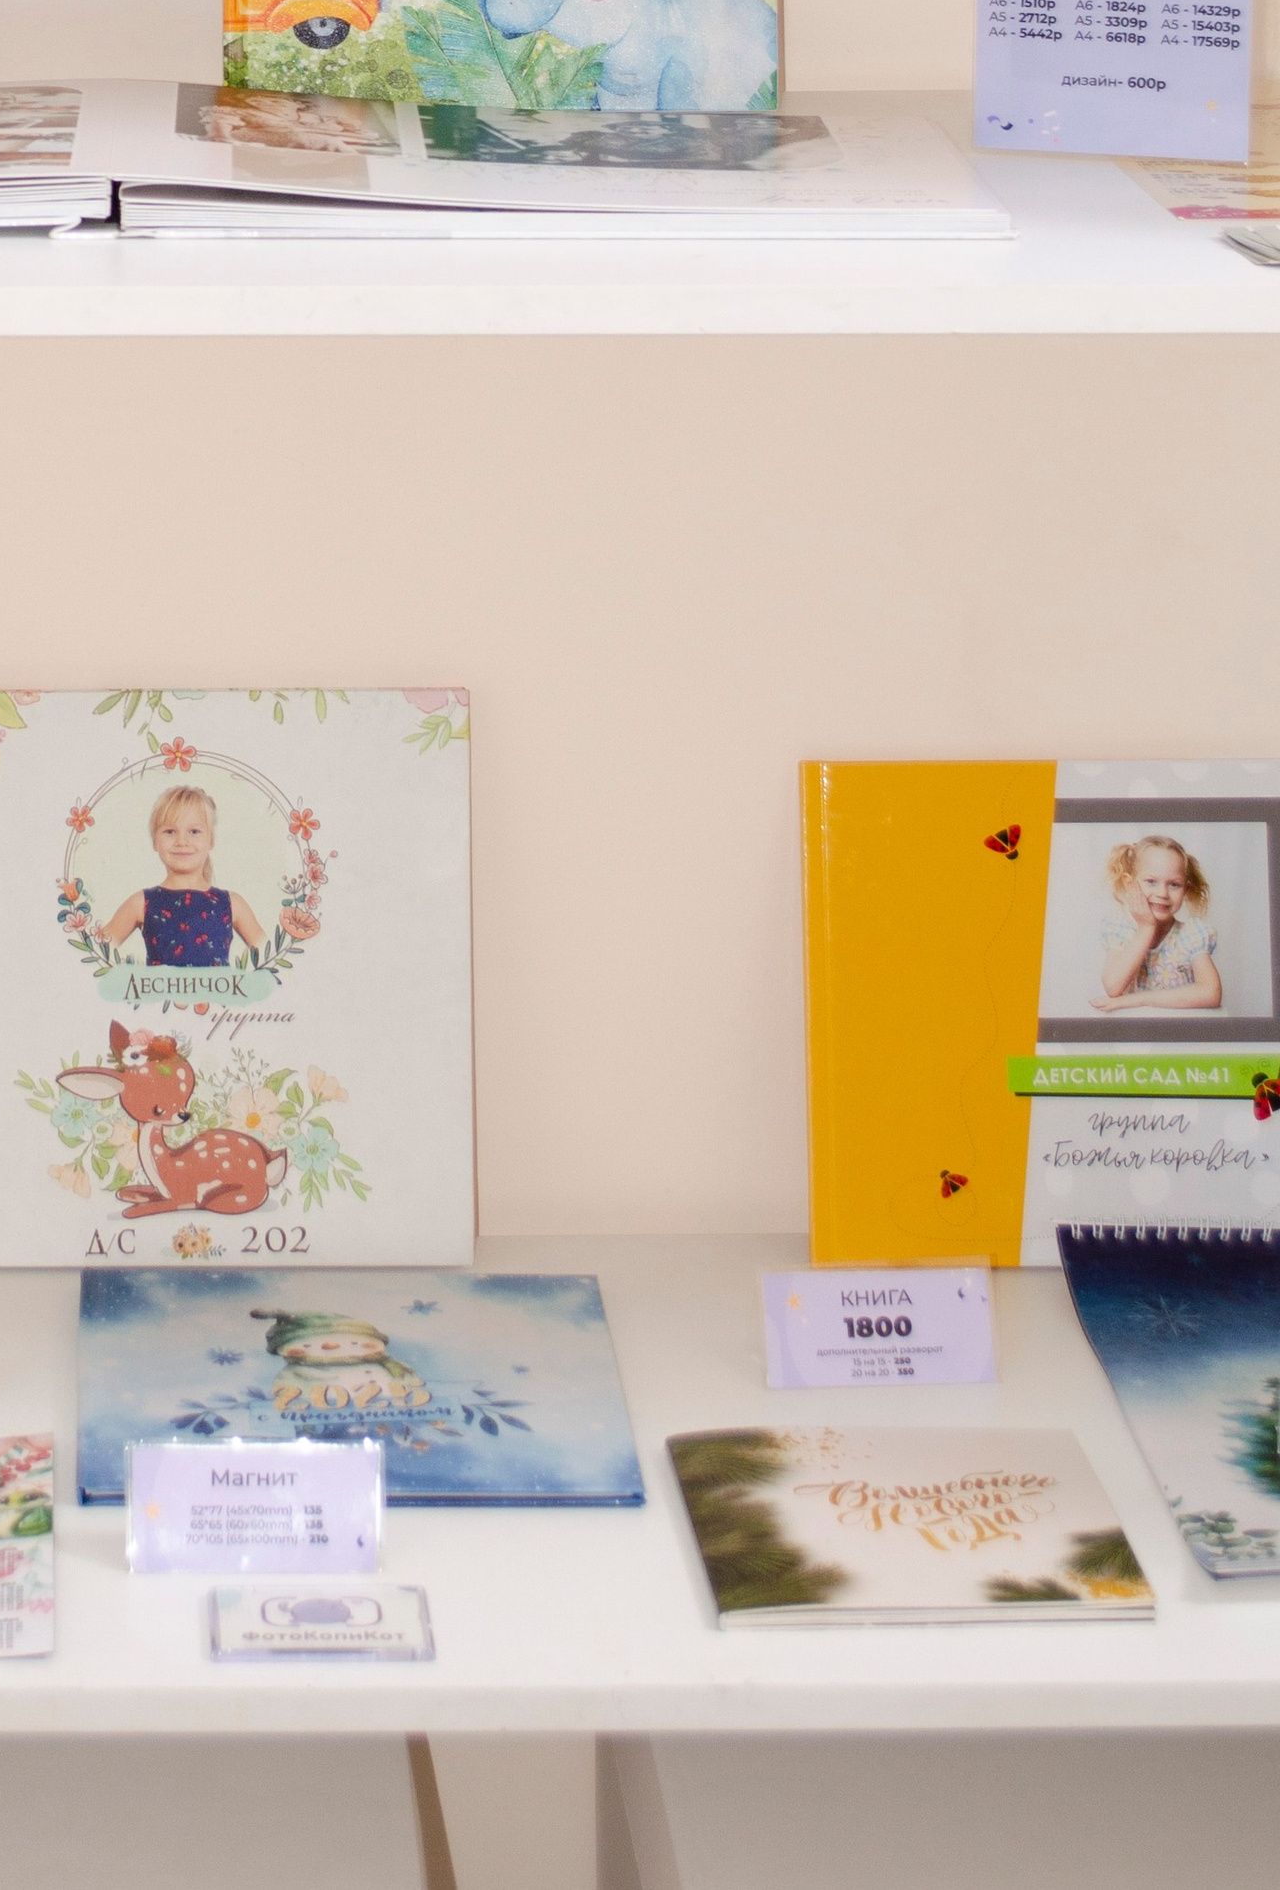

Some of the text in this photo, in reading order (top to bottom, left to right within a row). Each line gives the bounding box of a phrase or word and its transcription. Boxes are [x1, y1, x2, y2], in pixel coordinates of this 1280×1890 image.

[1105, 0, 1147, 15] 1824р
[1192, 4, 1241, 20] 14329р
[1018, 12, 1057, 27] 2712р
[1104, 16, 1148, 31] 3309р
[1191, 20, 1241, 35] 15403р
[1019, 28, 1063, 43] 5442р
[1105, 31, 1147, 46] 6618р
[1192, 35, 1241, 51] 17569р
[1127, 76, 1167, 92] 600р
[205, 1009, 296, 1041] группа
[1033, 1063, 1230, 1086] ДЕТСКИЙ САД №41
[1087, 1111, 1191, 1138] группа
[85, 1226, 311, 1258] Д/С 202
[840, 1289, 913, 1307] КНИГА
[843, 1315, 913, 1339] 1800
[211, 1468, 298, 1487] Магнит
